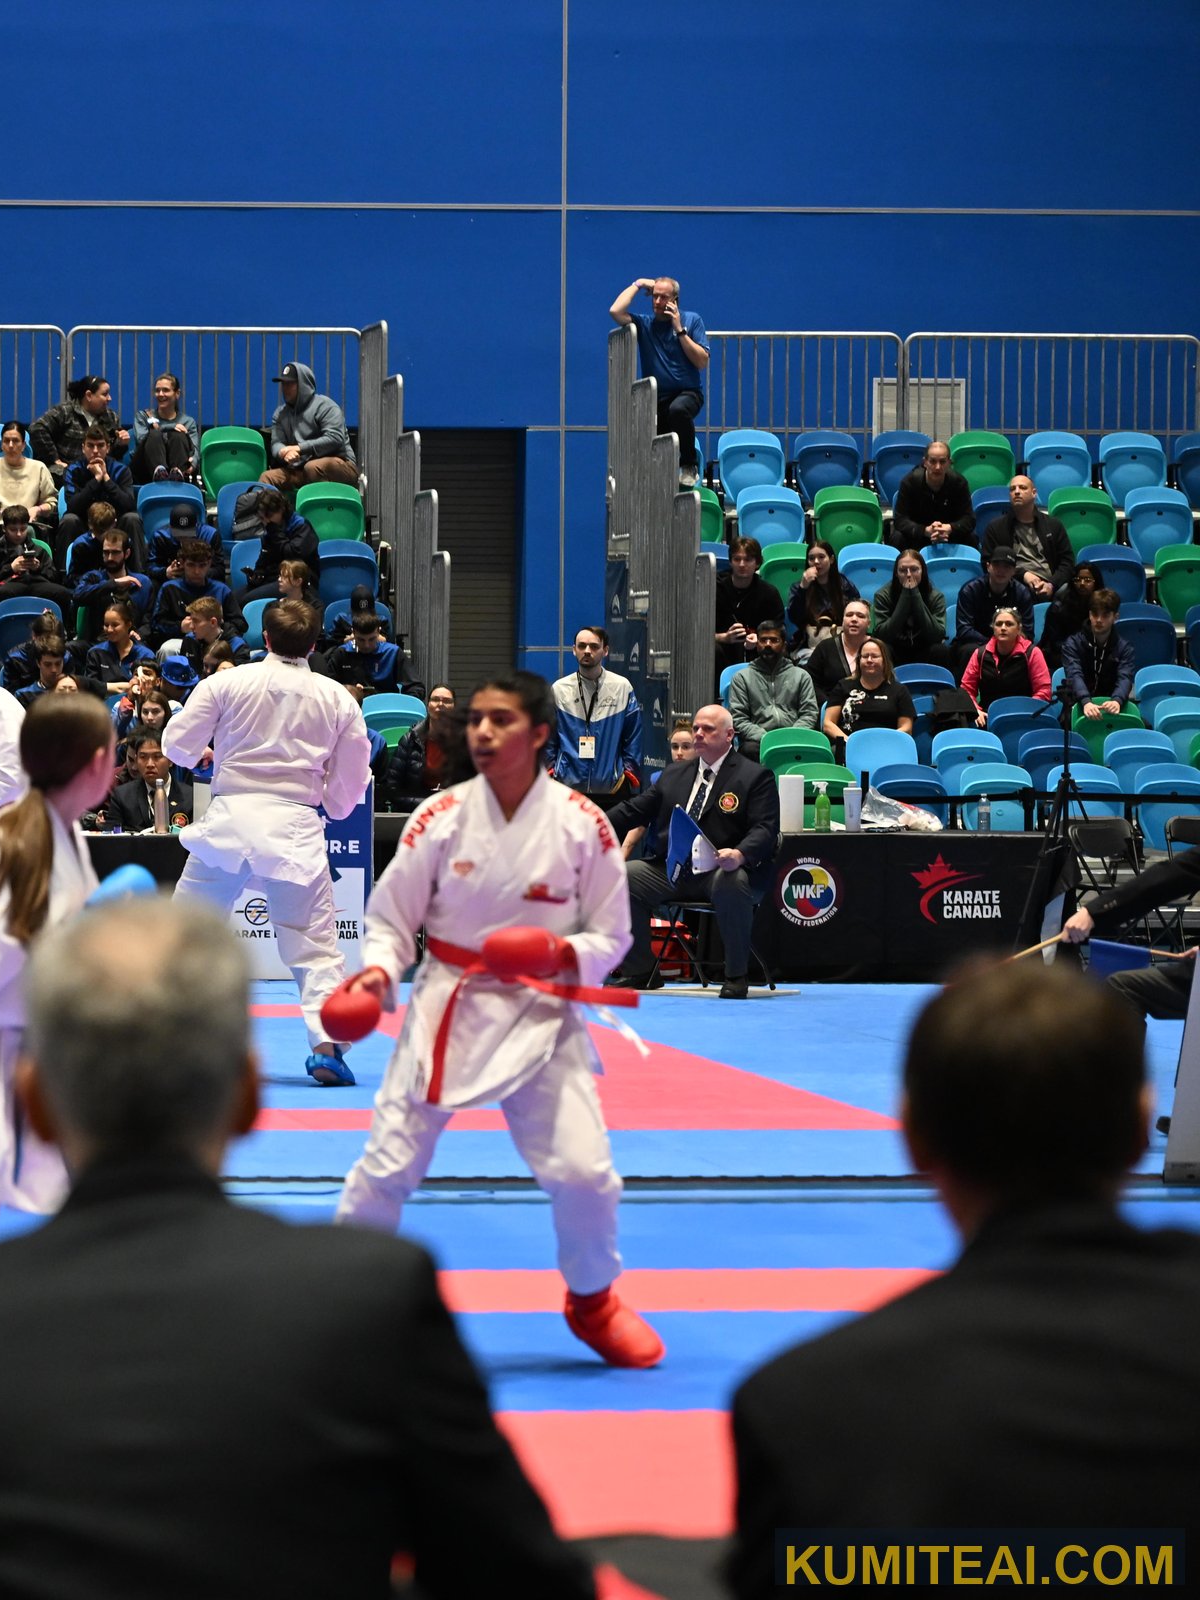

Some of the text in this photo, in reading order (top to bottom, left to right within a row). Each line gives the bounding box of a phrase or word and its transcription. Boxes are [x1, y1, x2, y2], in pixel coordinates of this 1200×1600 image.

[796, 856, 821, 865] WORLD
[792, 884, 825, 899] WKF
[943, 890, 1001, 904] KARATE
[780, 905, 839, 927] KARATE FEDERATION
[943, 905, 1002, 919] CANADA
[334, 920, 358, 929] RATE
[234, 929, 270, 938] ARATE
